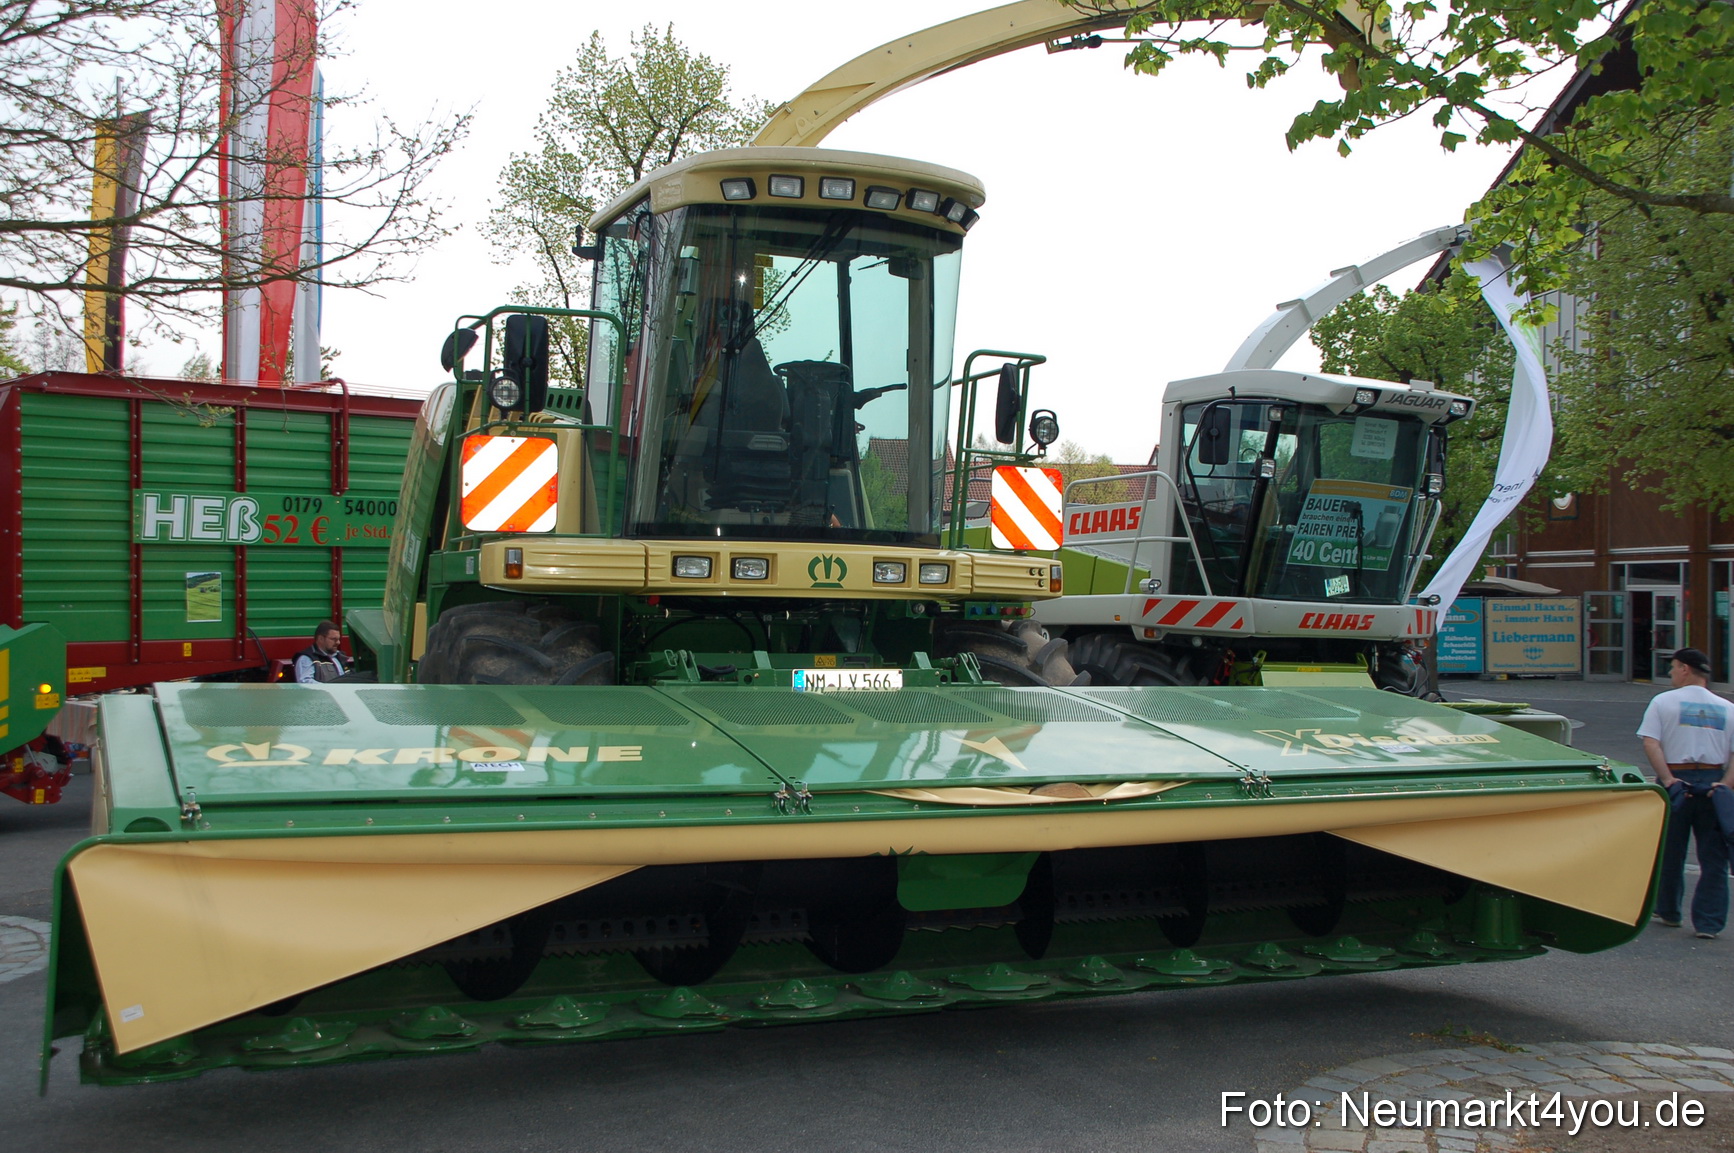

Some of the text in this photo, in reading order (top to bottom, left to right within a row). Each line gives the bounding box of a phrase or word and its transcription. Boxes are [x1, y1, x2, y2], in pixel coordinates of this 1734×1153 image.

[1385, 393, 1446, 409] JAGUAR
[283, 497, 397, 516] 0179 54000
[141, 493, 262, 544] HEß
[1069, 506, 1142, 535] CLAAS
[263, 515, 330, 545] 52 €
[344, 524, 359, 540] je
[1297, 523, 1334, 536] FAIREN
[1292, 540, 1359, 564] 40 Cent
[1492, 603, 1531, 611] Einmal
[1298, 612, 1376, 631] CLAAS
[1504, 614, 1540, 623] immer
[1492, 631, 1576, 643] Liebermann
[322, 745, 643, 765] KRONE
